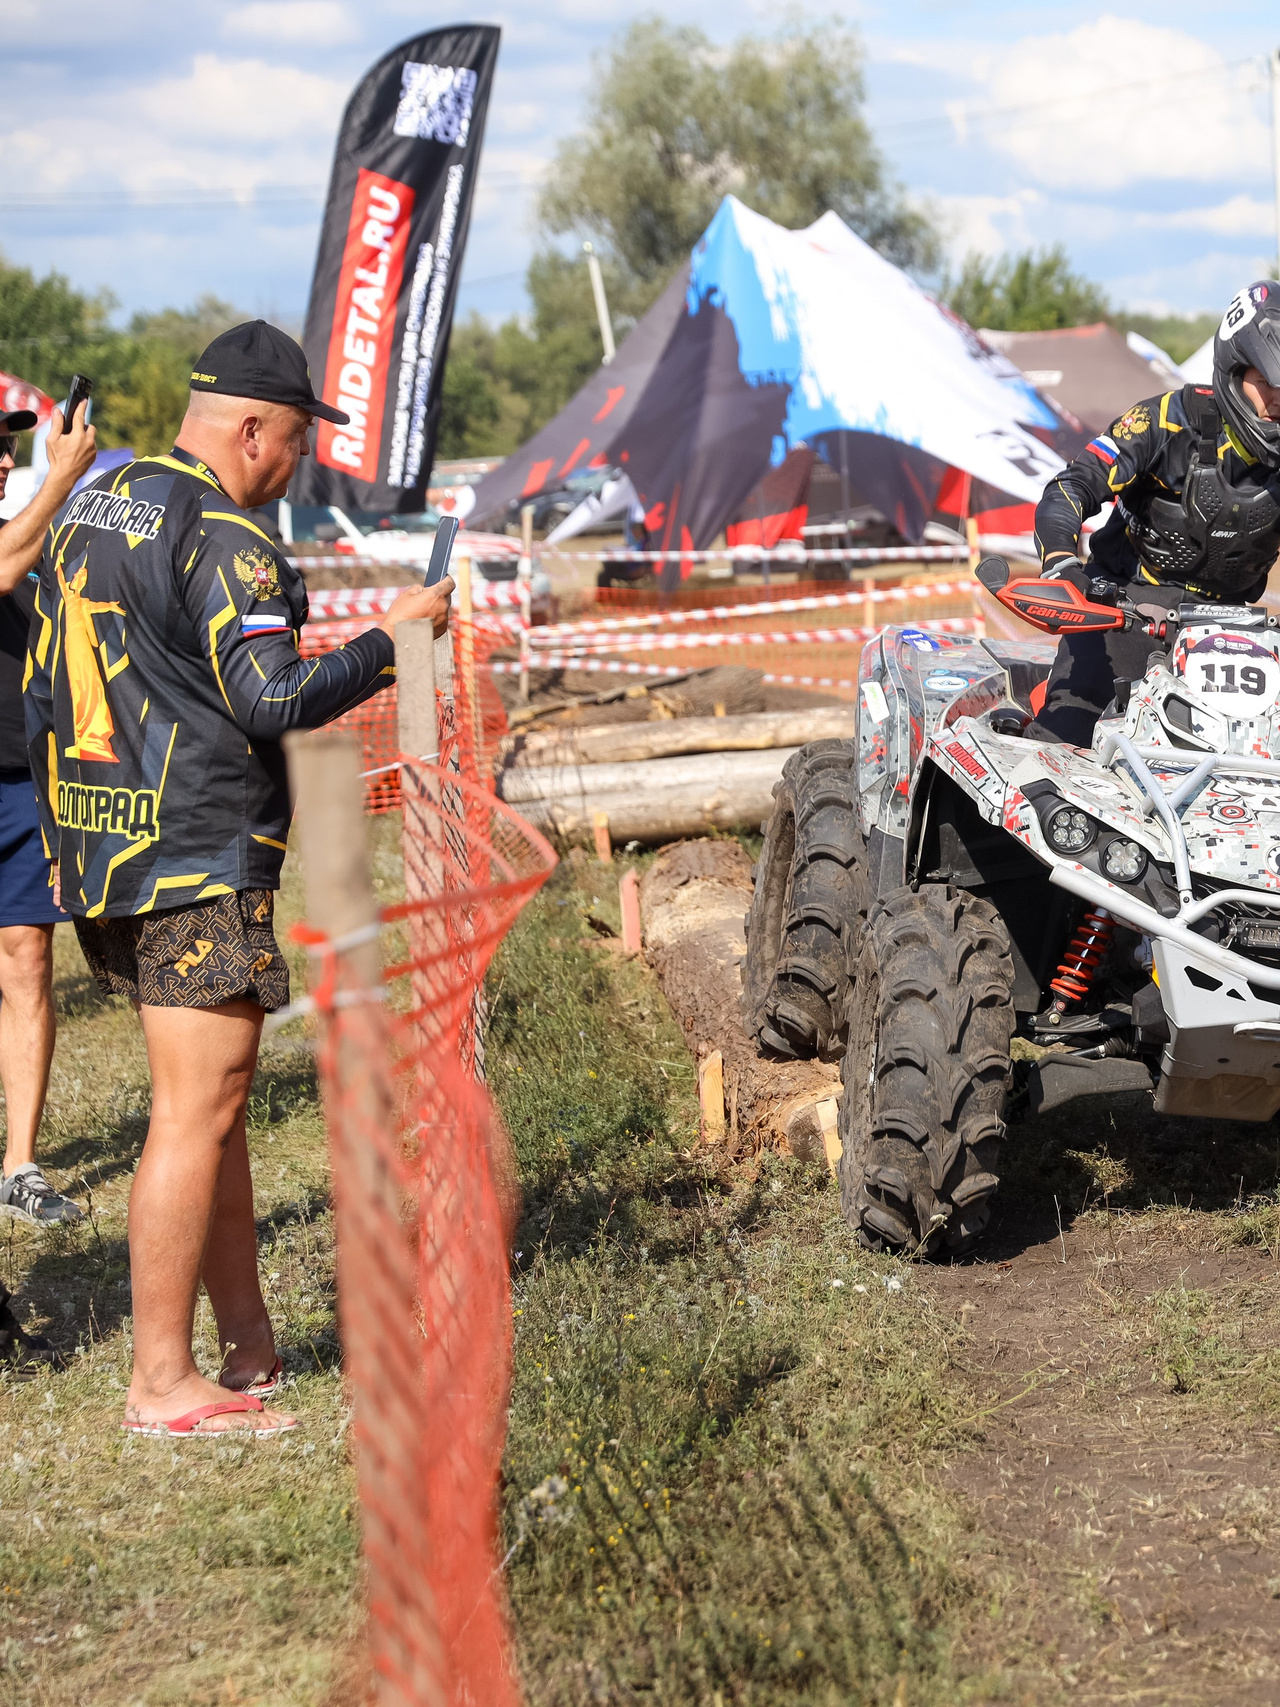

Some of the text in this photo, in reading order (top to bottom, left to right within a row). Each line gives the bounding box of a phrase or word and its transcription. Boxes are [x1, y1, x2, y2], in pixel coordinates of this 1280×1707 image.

[330, 186, 401, 470] RMDETAL.RU
[1026, 605, 1086, 623] can-am
[1201, 664, 1266, 696] 119
[174, 939, 214, 978] FILA
